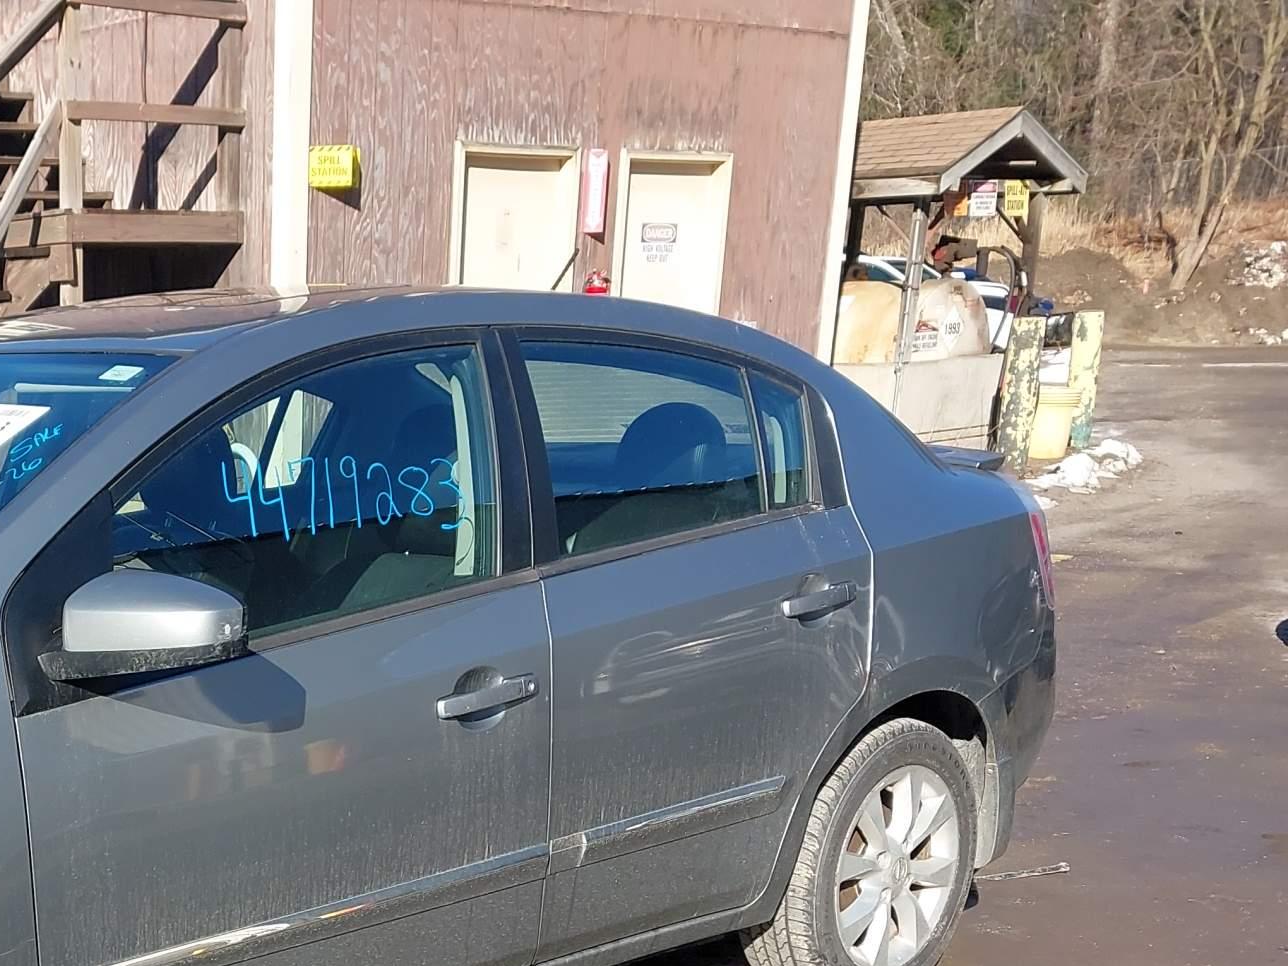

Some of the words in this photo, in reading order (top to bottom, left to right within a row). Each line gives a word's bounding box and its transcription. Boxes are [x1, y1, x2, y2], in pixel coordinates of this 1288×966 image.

[317, 155, 343, 165] SPILL
[311, 167, 348, 177] STATION
[222, 455, 465, 542] 44719283
